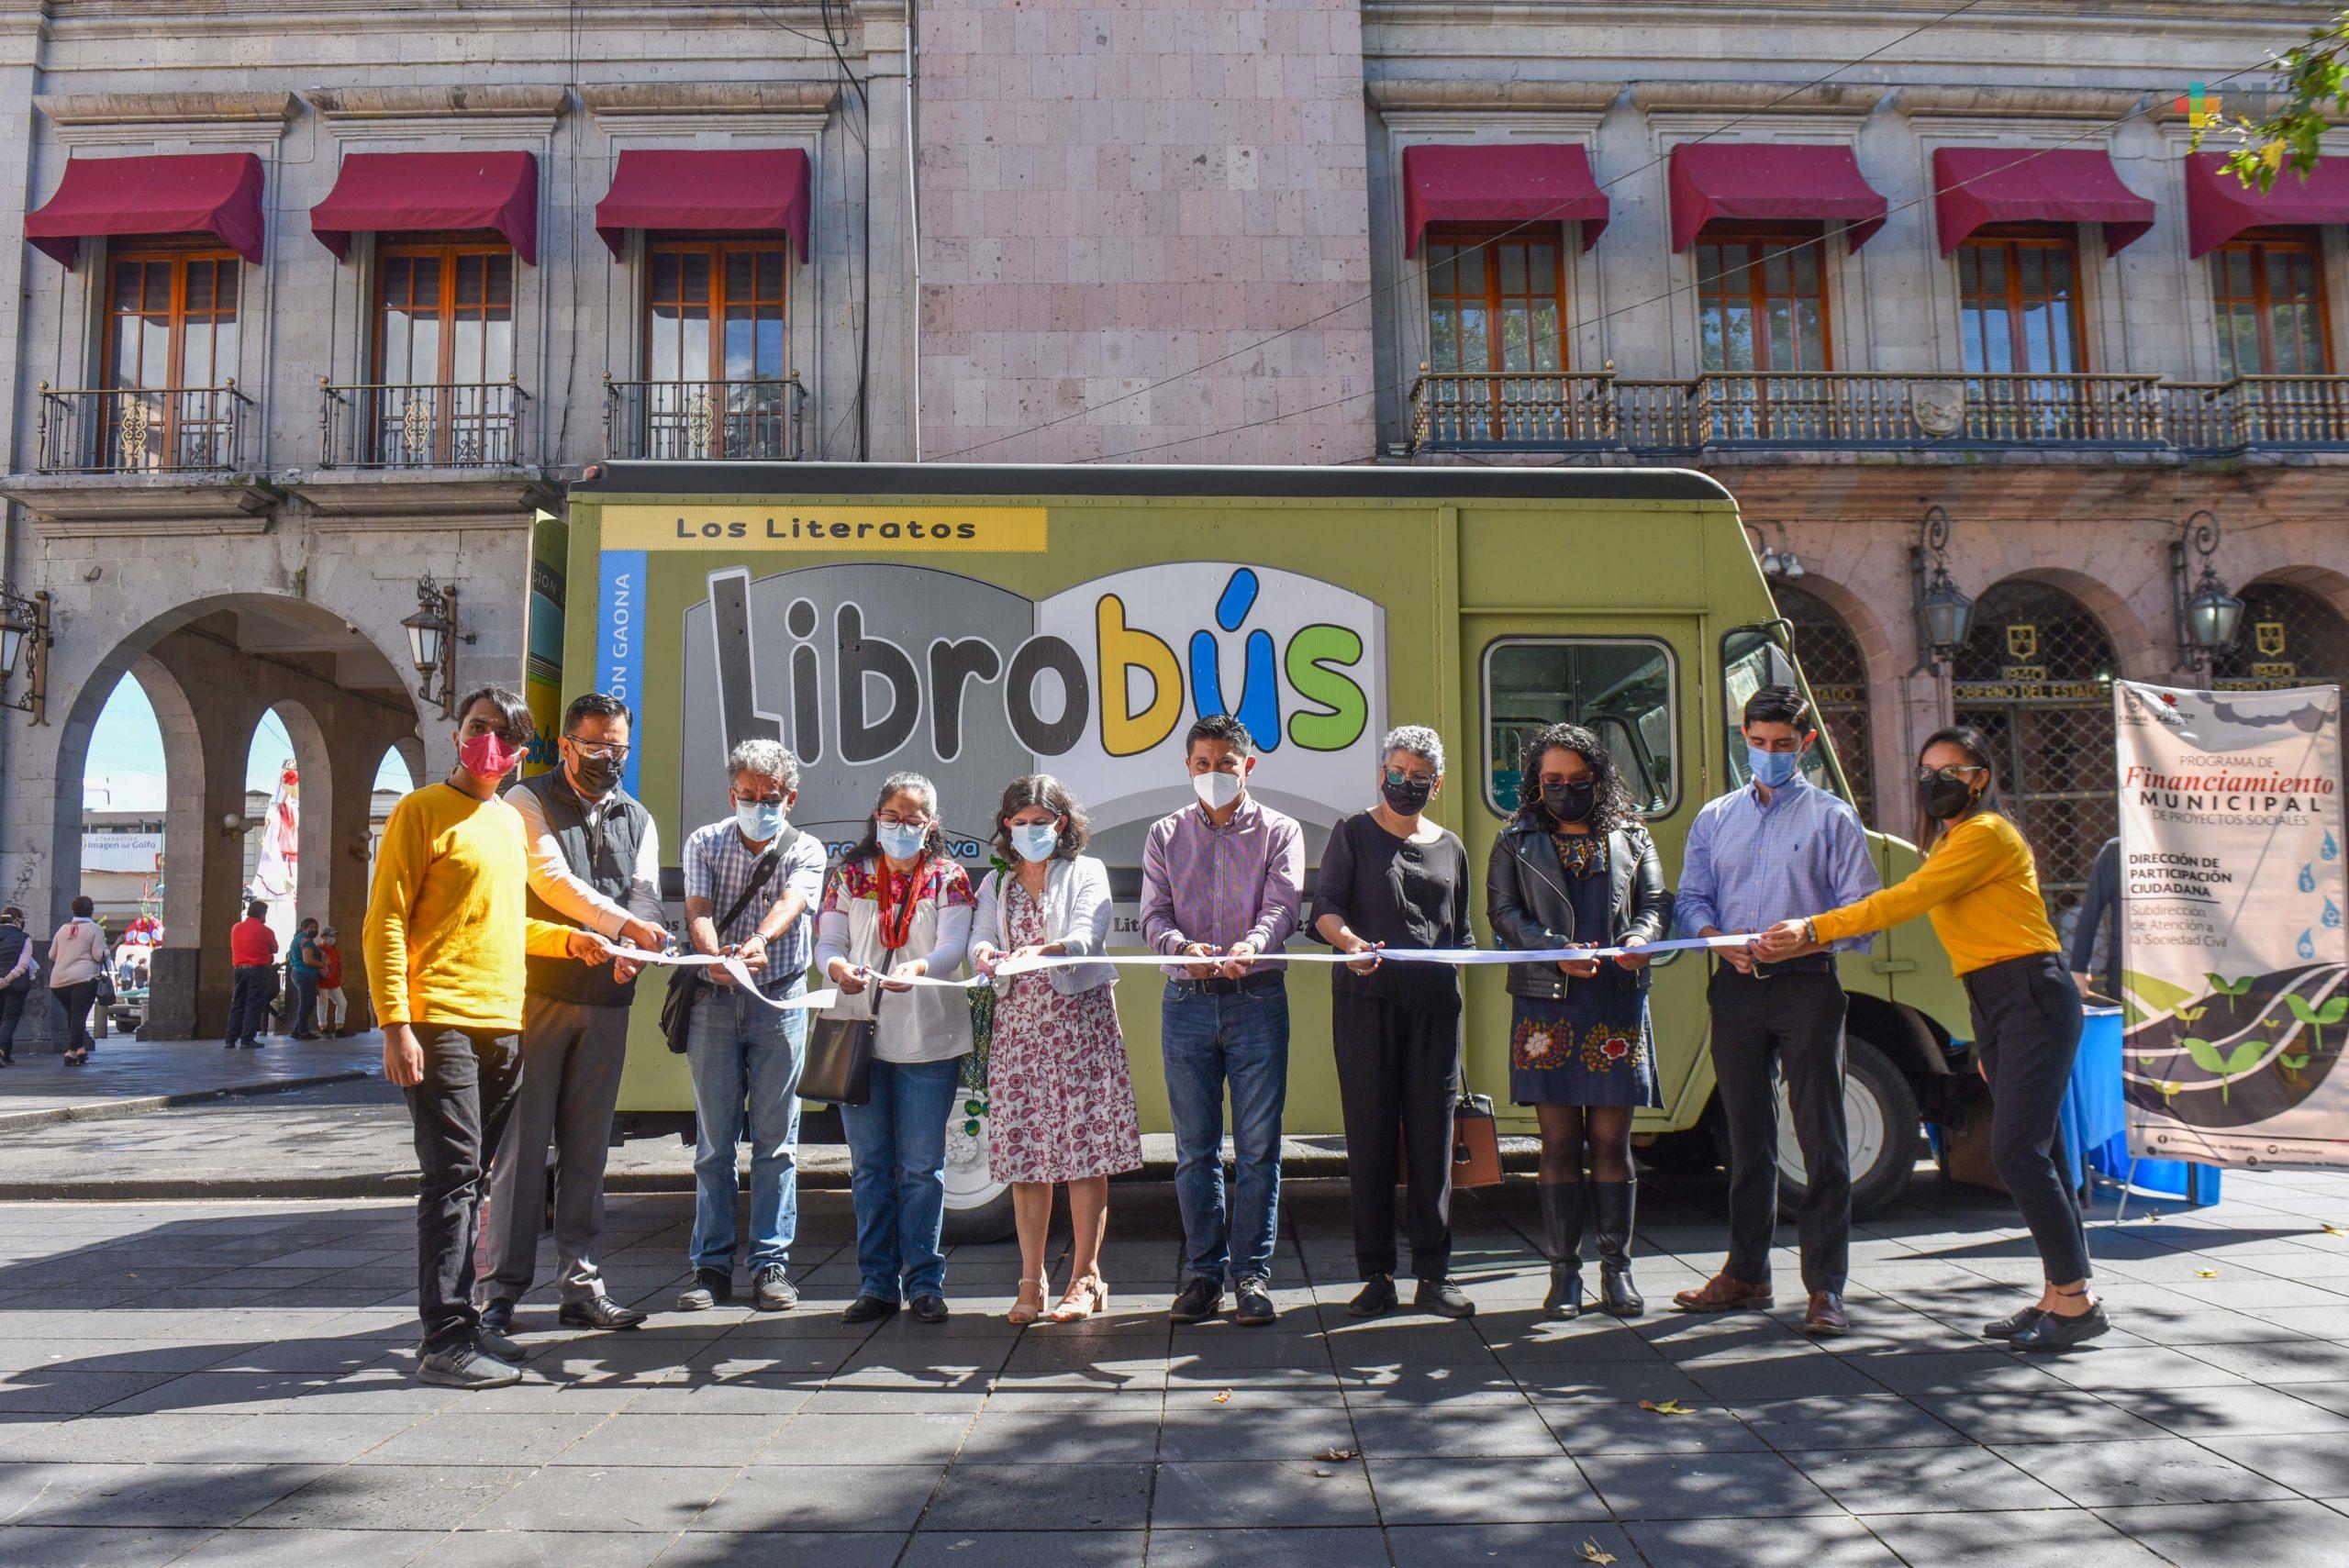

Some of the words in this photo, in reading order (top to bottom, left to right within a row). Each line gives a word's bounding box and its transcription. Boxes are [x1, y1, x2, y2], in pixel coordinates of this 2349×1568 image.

[677, 518, 747, 539] Los
[766, 517, 977, 539] Literatos
[612, 573, 630, 659] GAONA
[707, 565, 1369, 767] Librobús
[1954, 684, 2017, 699] OBIERNO
[2179, 755, 2254, 768] PROGRAMA
[2258, 757, 2275, 768] DE
[2122, 765, 2334, 795] Financiamiento
[2140, 791, 2321, 812] MUNICIPAL
[2153, 809, 2167, 822] DE
[2169, 810, 2243, 825] PROYECTOS
[2247, 814, 2310, 826] SOCIALES
[87, 840, 119, 851] Imagen
[131, 840, 156, 849] Golfo
[2129, 852, 2199, 867] DIRECCIÓN
[2201, 858, 2220, 868] DE
[2130, 868, 2232, 883] PARTICIPACIÓN
[2131, 884, 2211, 897] CIUDADANA
[2132, 905, 2206, 917] Subdirección
[2131, 920, 2145, 930] de
[2150, 920, 2204, 931] Atención
[2206, 924, 2214, 932] a
[2144, 934, 2200, 946] Sociedad
[2204, 936, 2227, 948] Civil
